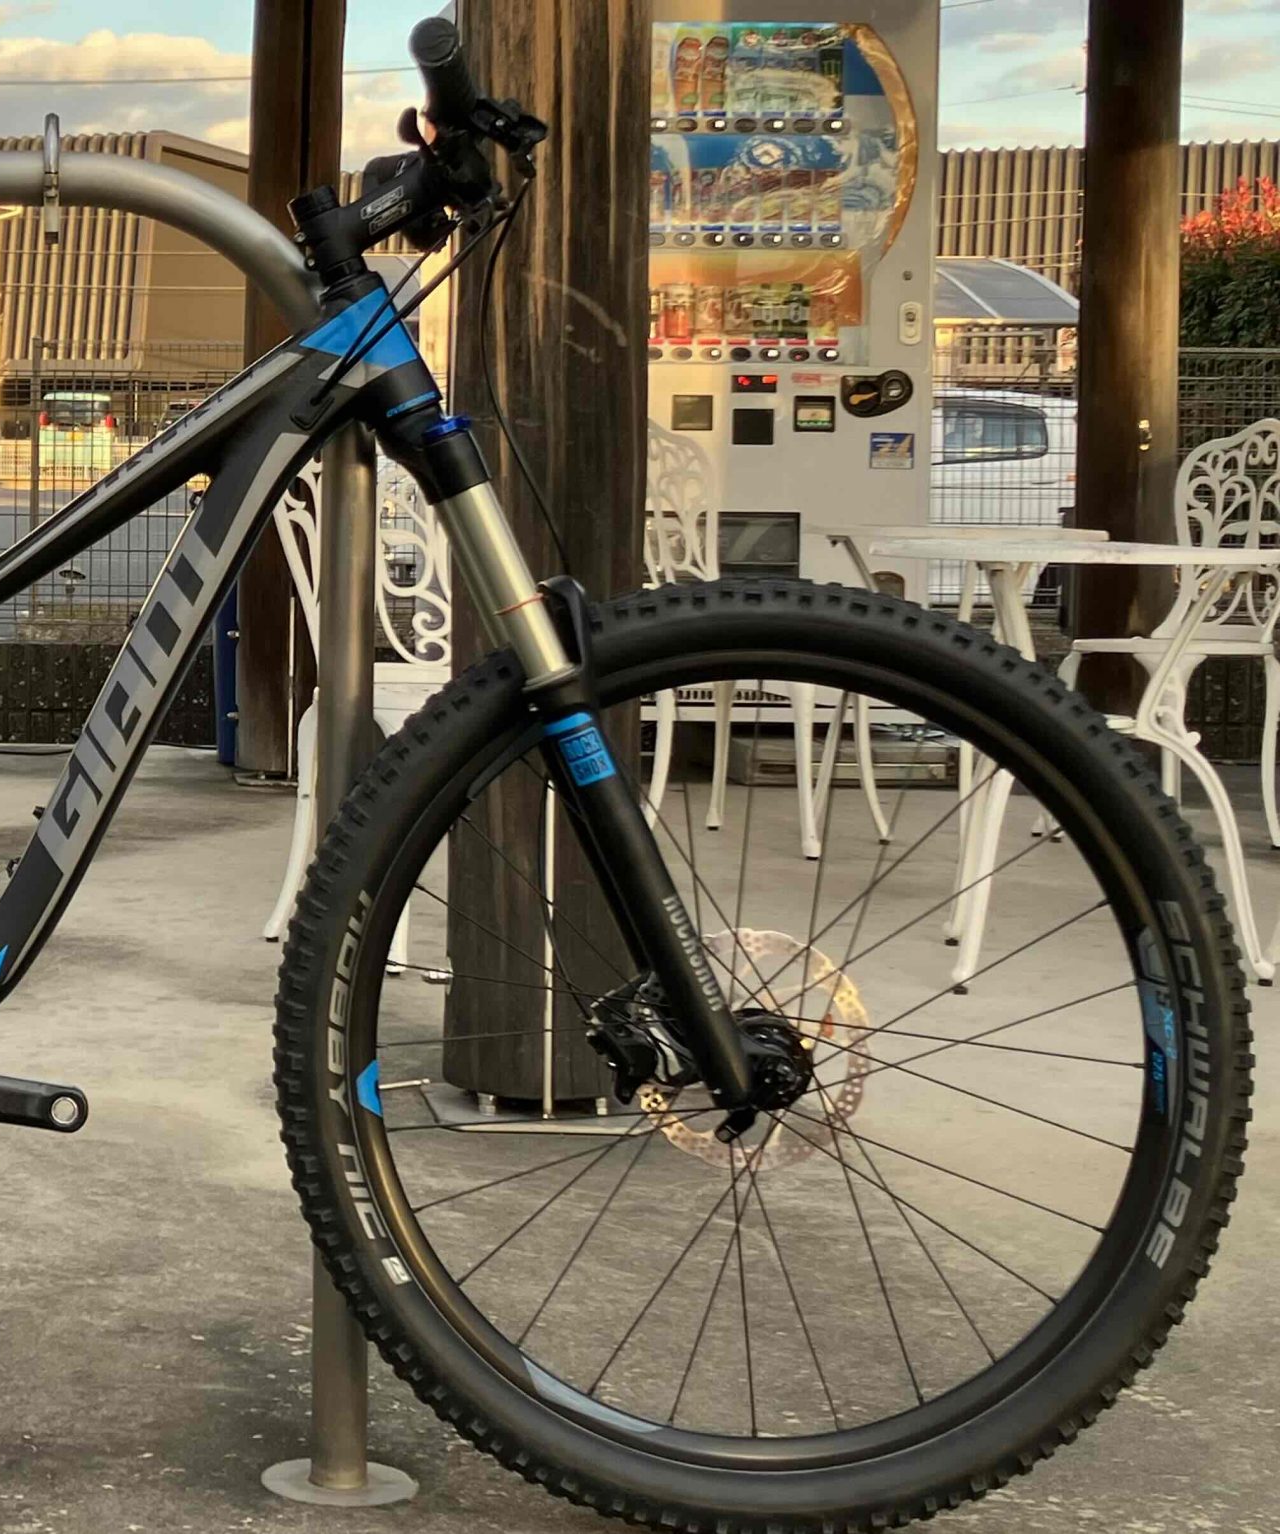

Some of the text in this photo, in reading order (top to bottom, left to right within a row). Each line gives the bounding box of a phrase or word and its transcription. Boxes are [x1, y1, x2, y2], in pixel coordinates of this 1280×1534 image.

[327, 889, 388, 1241] NOBBY NIC
[1145, 900, 1210, 1270] SCHWALBE
